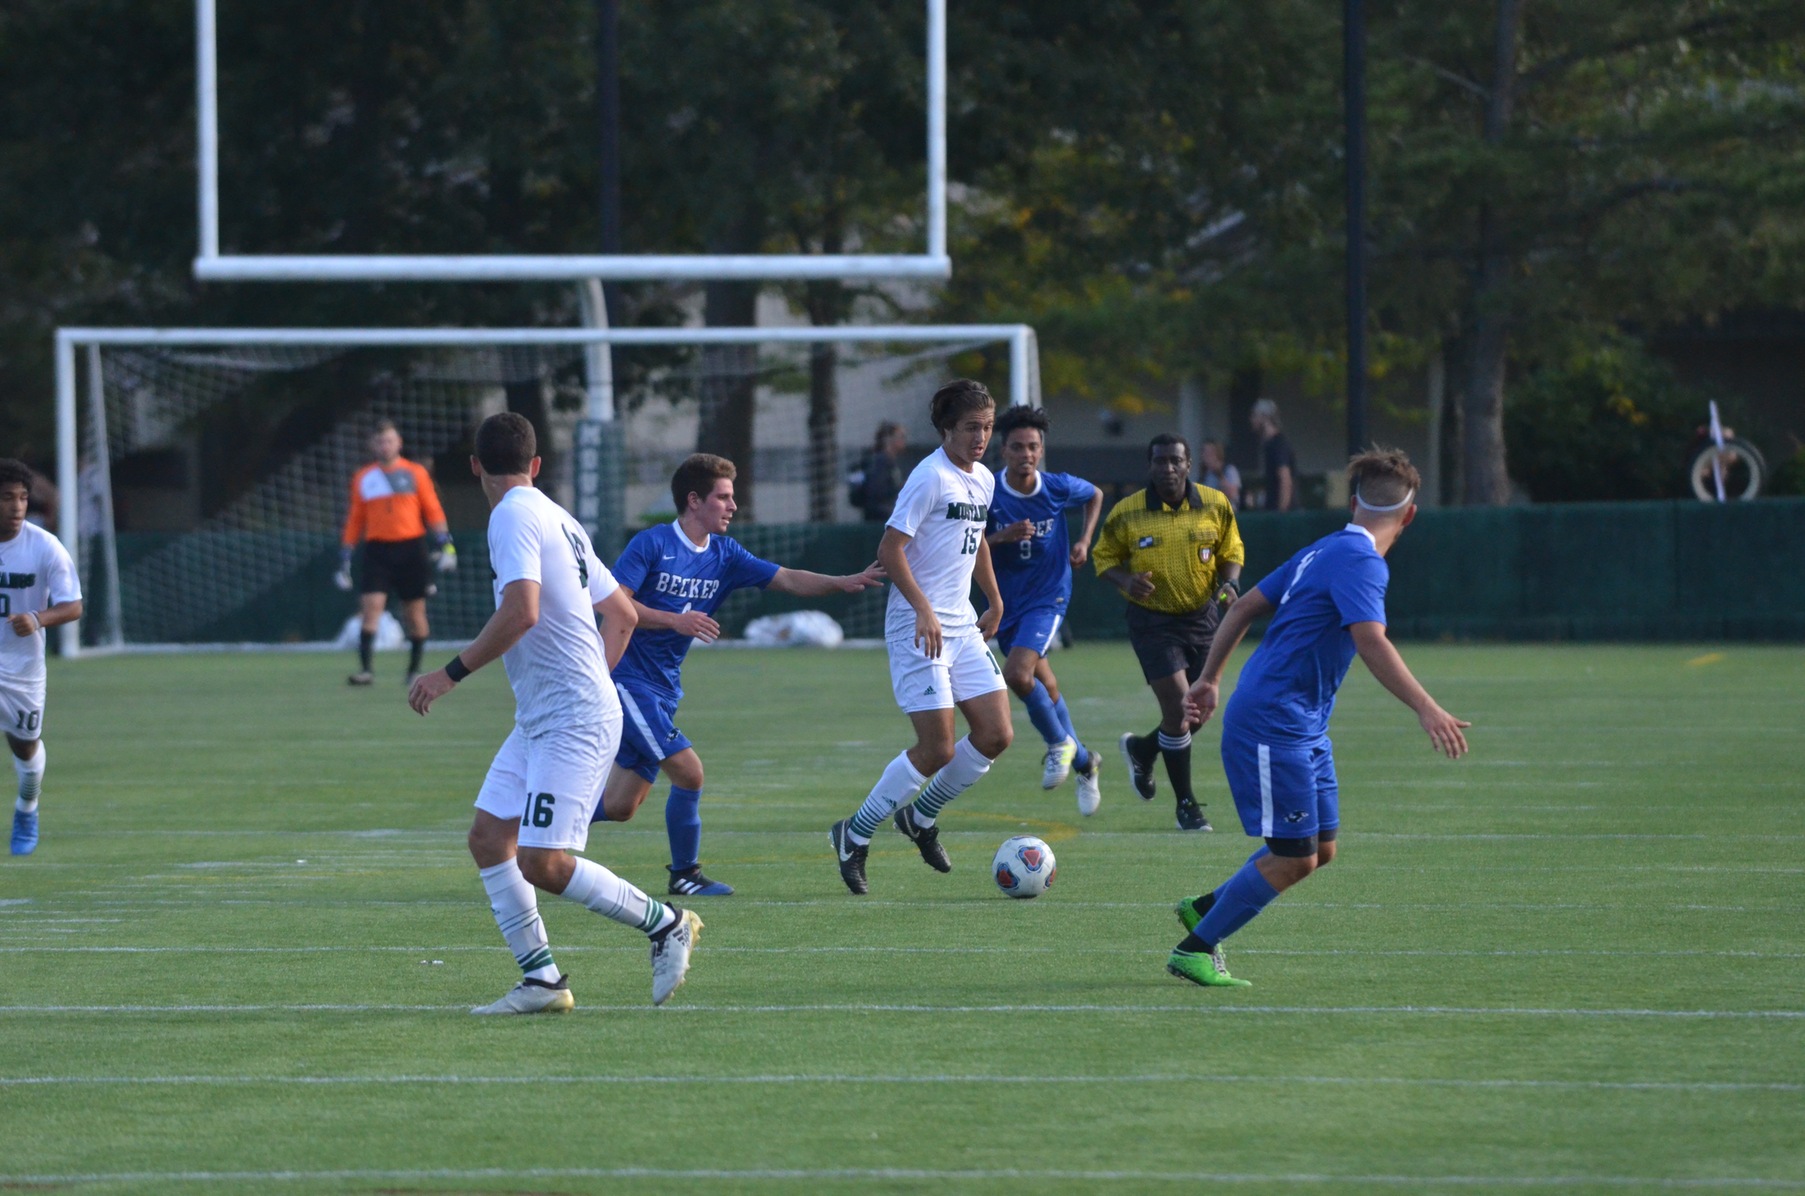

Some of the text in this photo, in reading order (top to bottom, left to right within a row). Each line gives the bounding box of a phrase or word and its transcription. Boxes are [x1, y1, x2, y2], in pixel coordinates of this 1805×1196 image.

[961, 527, 981, 554] 15
[1020, 540, 1032, 560] 9
[16, 709, 40, 731] 10
[522, 792, 556, 828] 16
